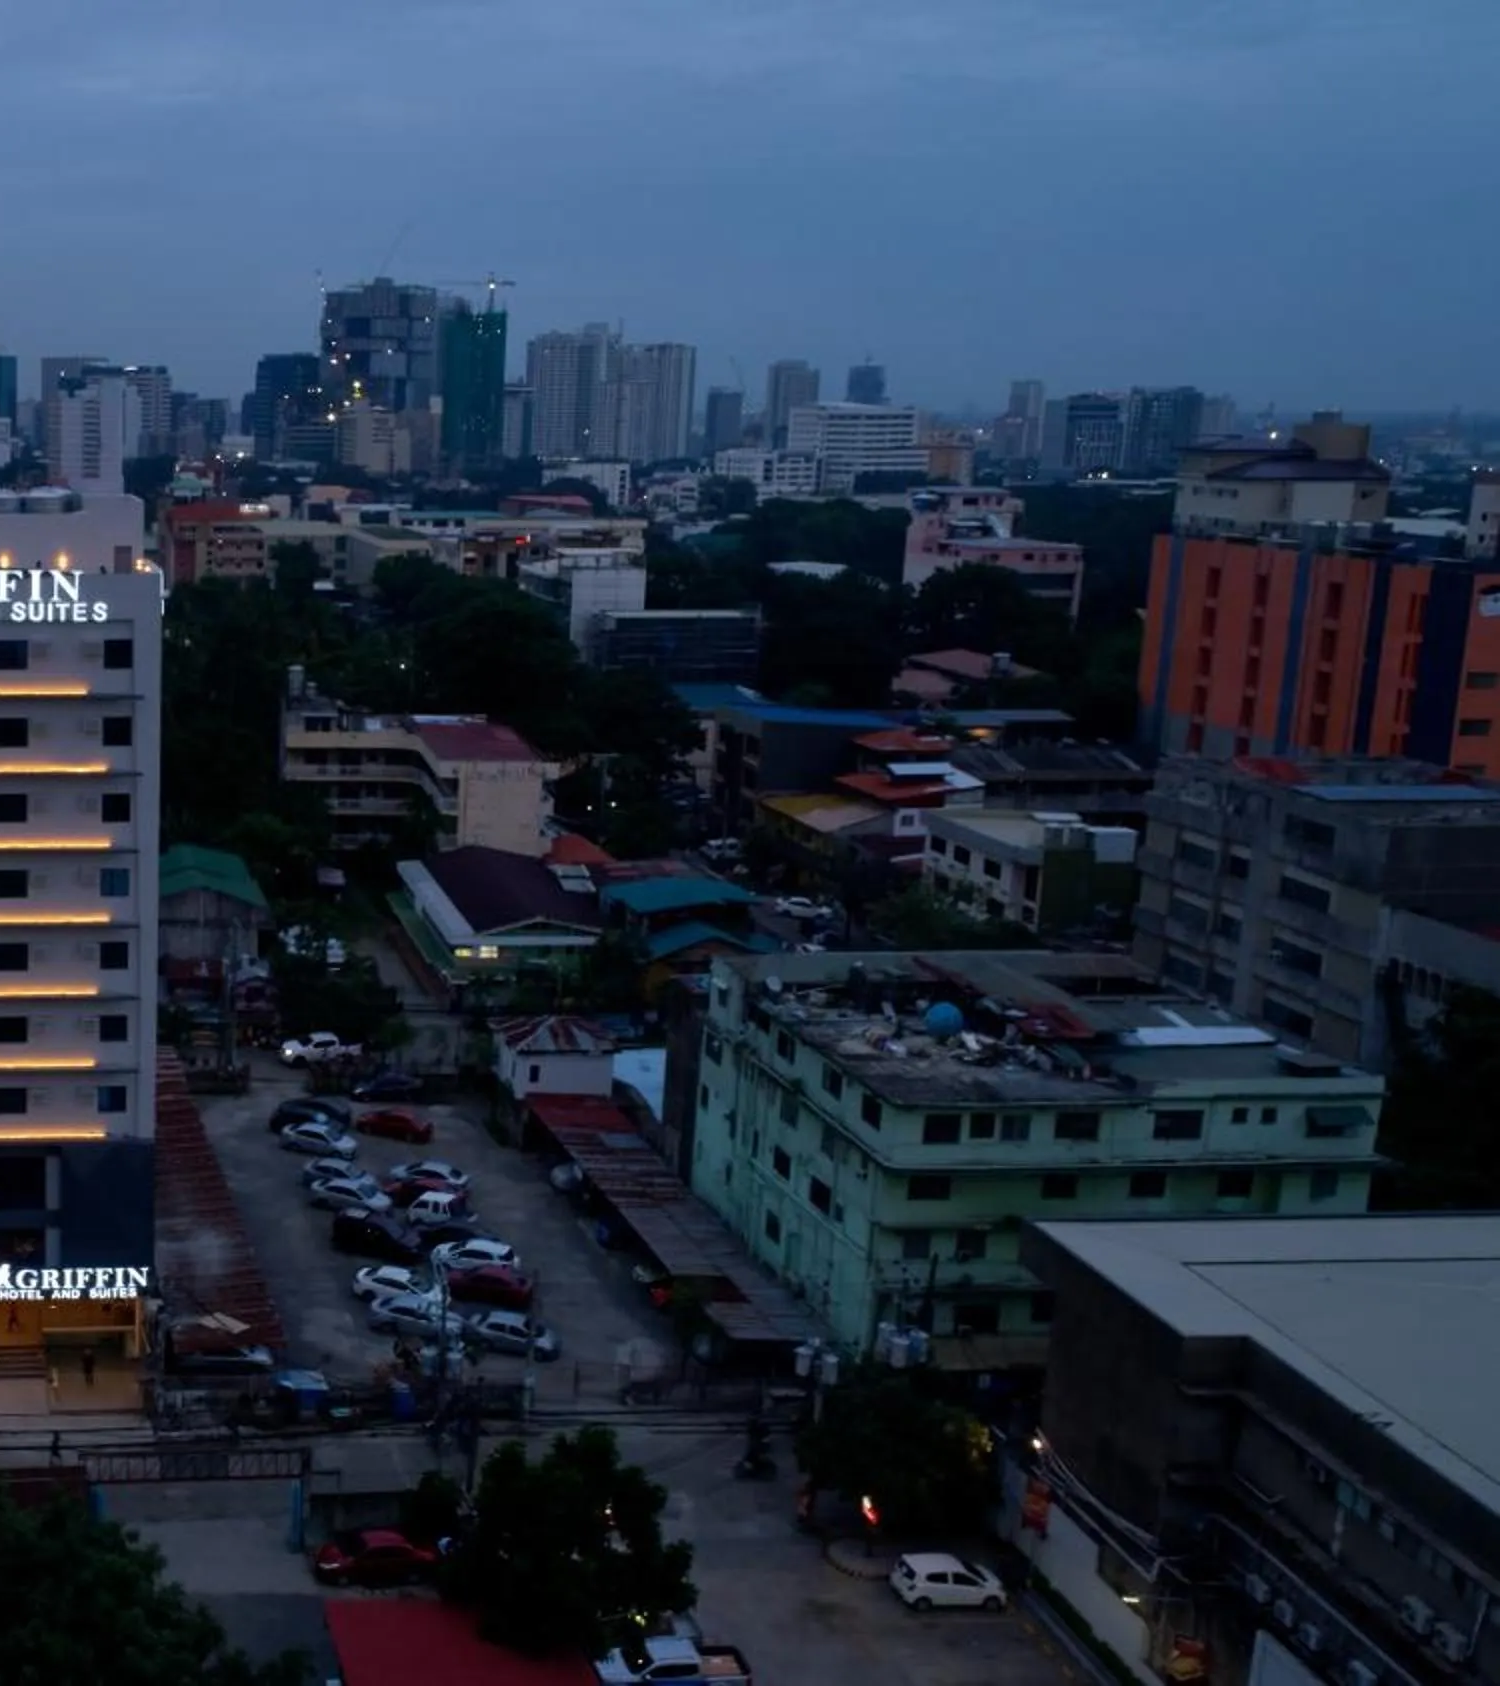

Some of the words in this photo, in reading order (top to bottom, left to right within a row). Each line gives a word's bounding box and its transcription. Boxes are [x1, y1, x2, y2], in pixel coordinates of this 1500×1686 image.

[11, 602, 108, 623] SUITES
[15, 1266, 149, 1290] GRIFFIN
[0, 1289, 45, 1300] HOTEL
[52, 1289, 80, 1300] AND
[89, 1287, 137, 1299] SUITES
